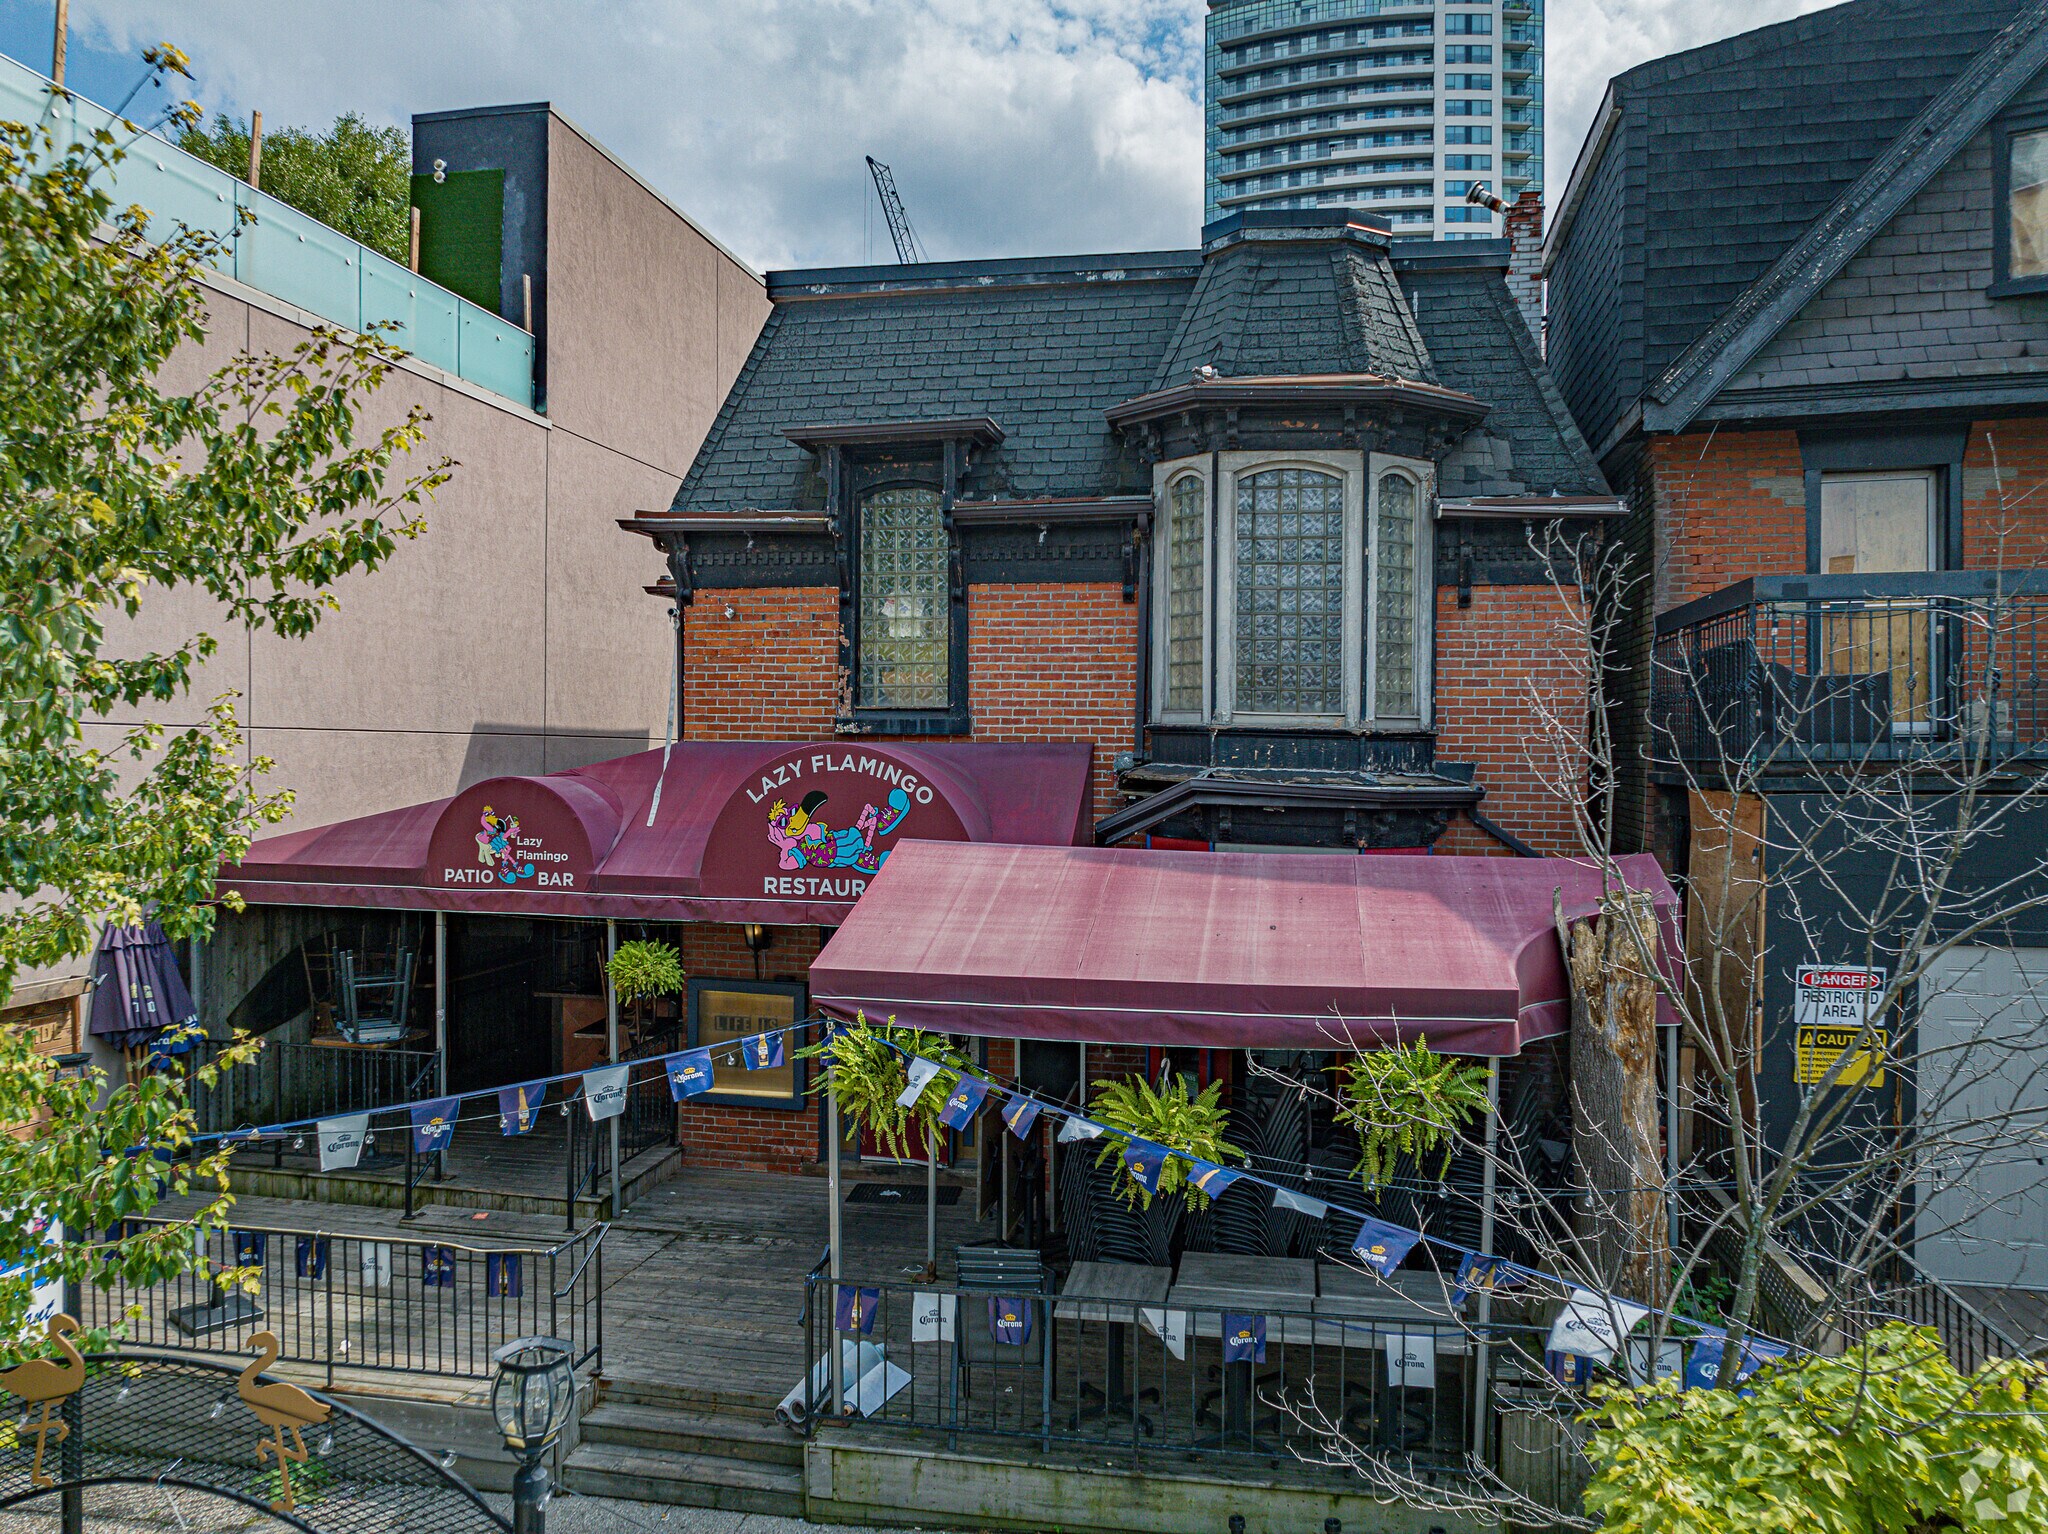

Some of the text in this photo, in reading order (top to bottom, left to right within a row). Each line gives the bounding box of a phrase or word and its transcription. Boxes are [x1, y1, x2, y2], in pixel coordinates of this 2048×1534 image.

[746, 754, 933, 804] LAZY FLAMINGO
[516, 836, 543, 847] Lazy
[516, 850, 568, 862] Flamingo
[444, 869, 574, 887] PATIO BAR
[1823, 1005, 1857, 1018] AREA
[716, 1016, 750, 1030] LIFE
[1817, 1033, 1880, 1048] CAUTO
[675, 1072, 705, 1084] Corona
[327, 1140, 359, 1152] Corona
[1640, 1361, 1672, 1372] Cona
